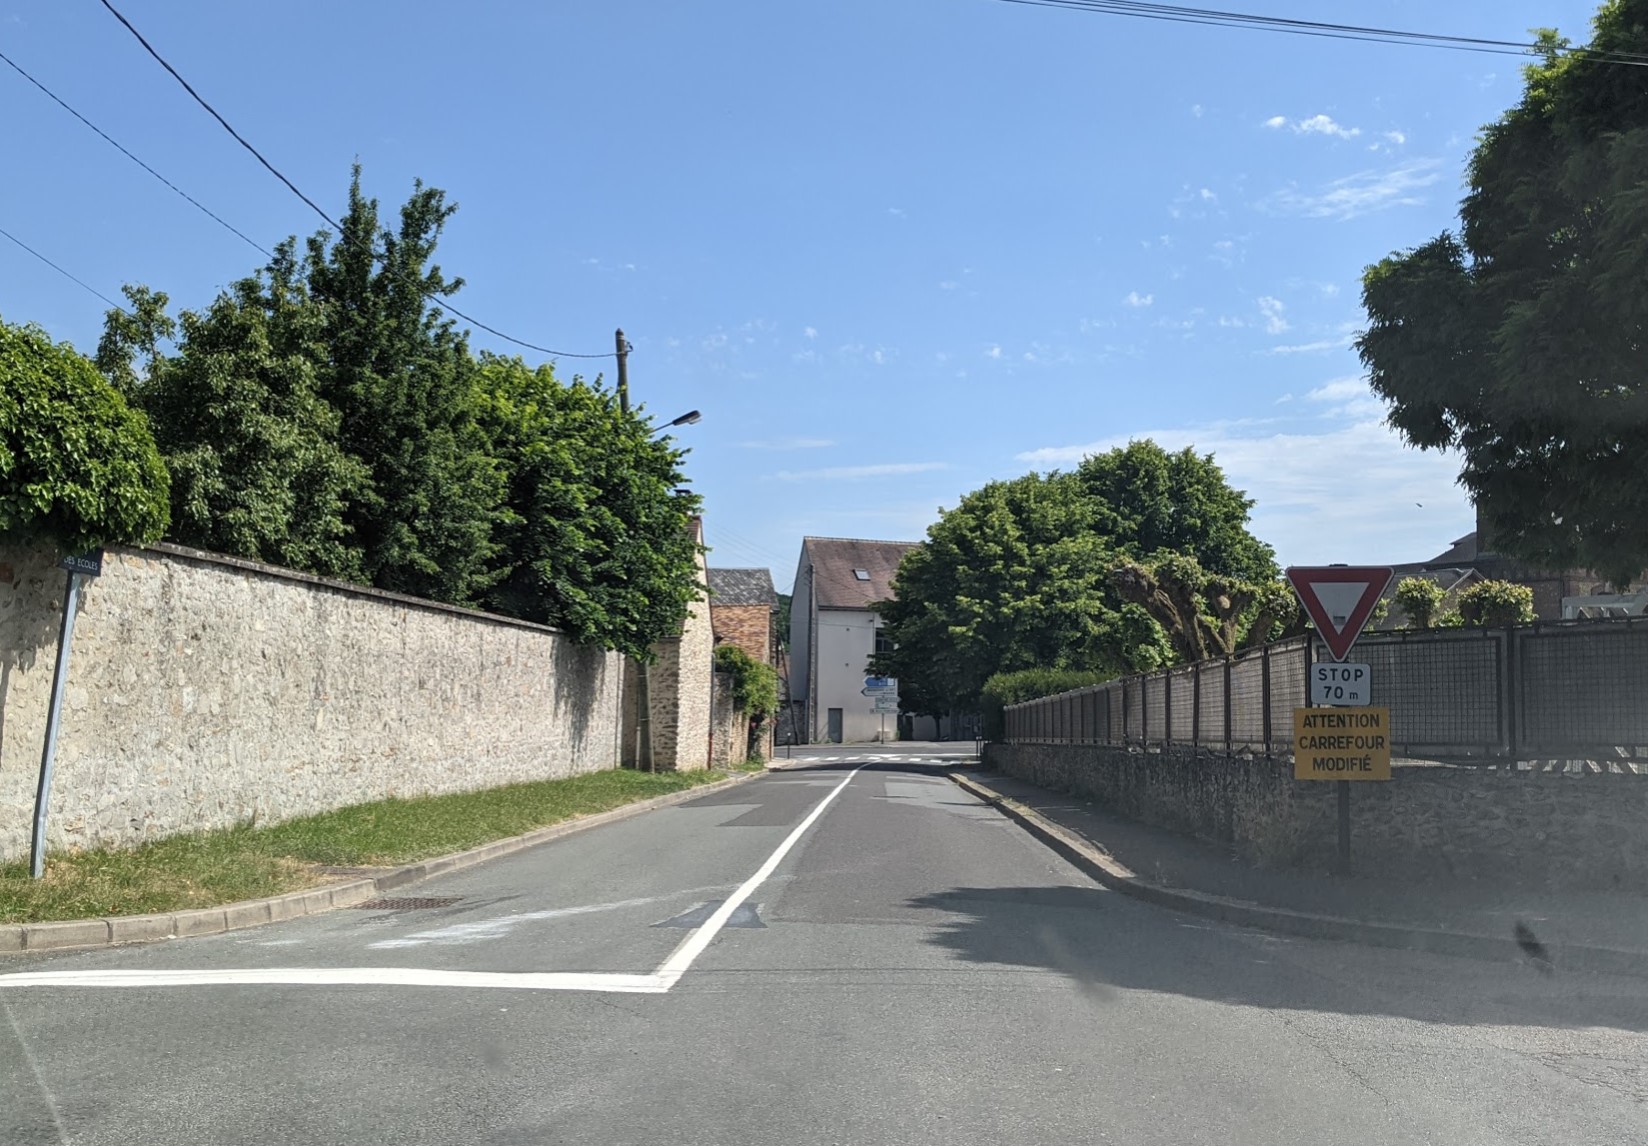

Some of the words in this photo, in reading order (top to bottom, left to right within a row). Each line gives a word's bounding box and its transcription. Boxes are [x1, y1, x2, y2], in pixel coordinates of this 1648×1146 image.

[77, 558, 98, 570] ECOLES
[1318, 668, 1364, 682] STOP
[1323, 686, 1343, 699] 70
[1349, 691, 1358, 700] m
[1302, 714, 1380, 728] ATTENTION
[1300, 736, 1384, 750] CARREFOUR
[1312, 754, 1372, 771] MODIFIÉ
